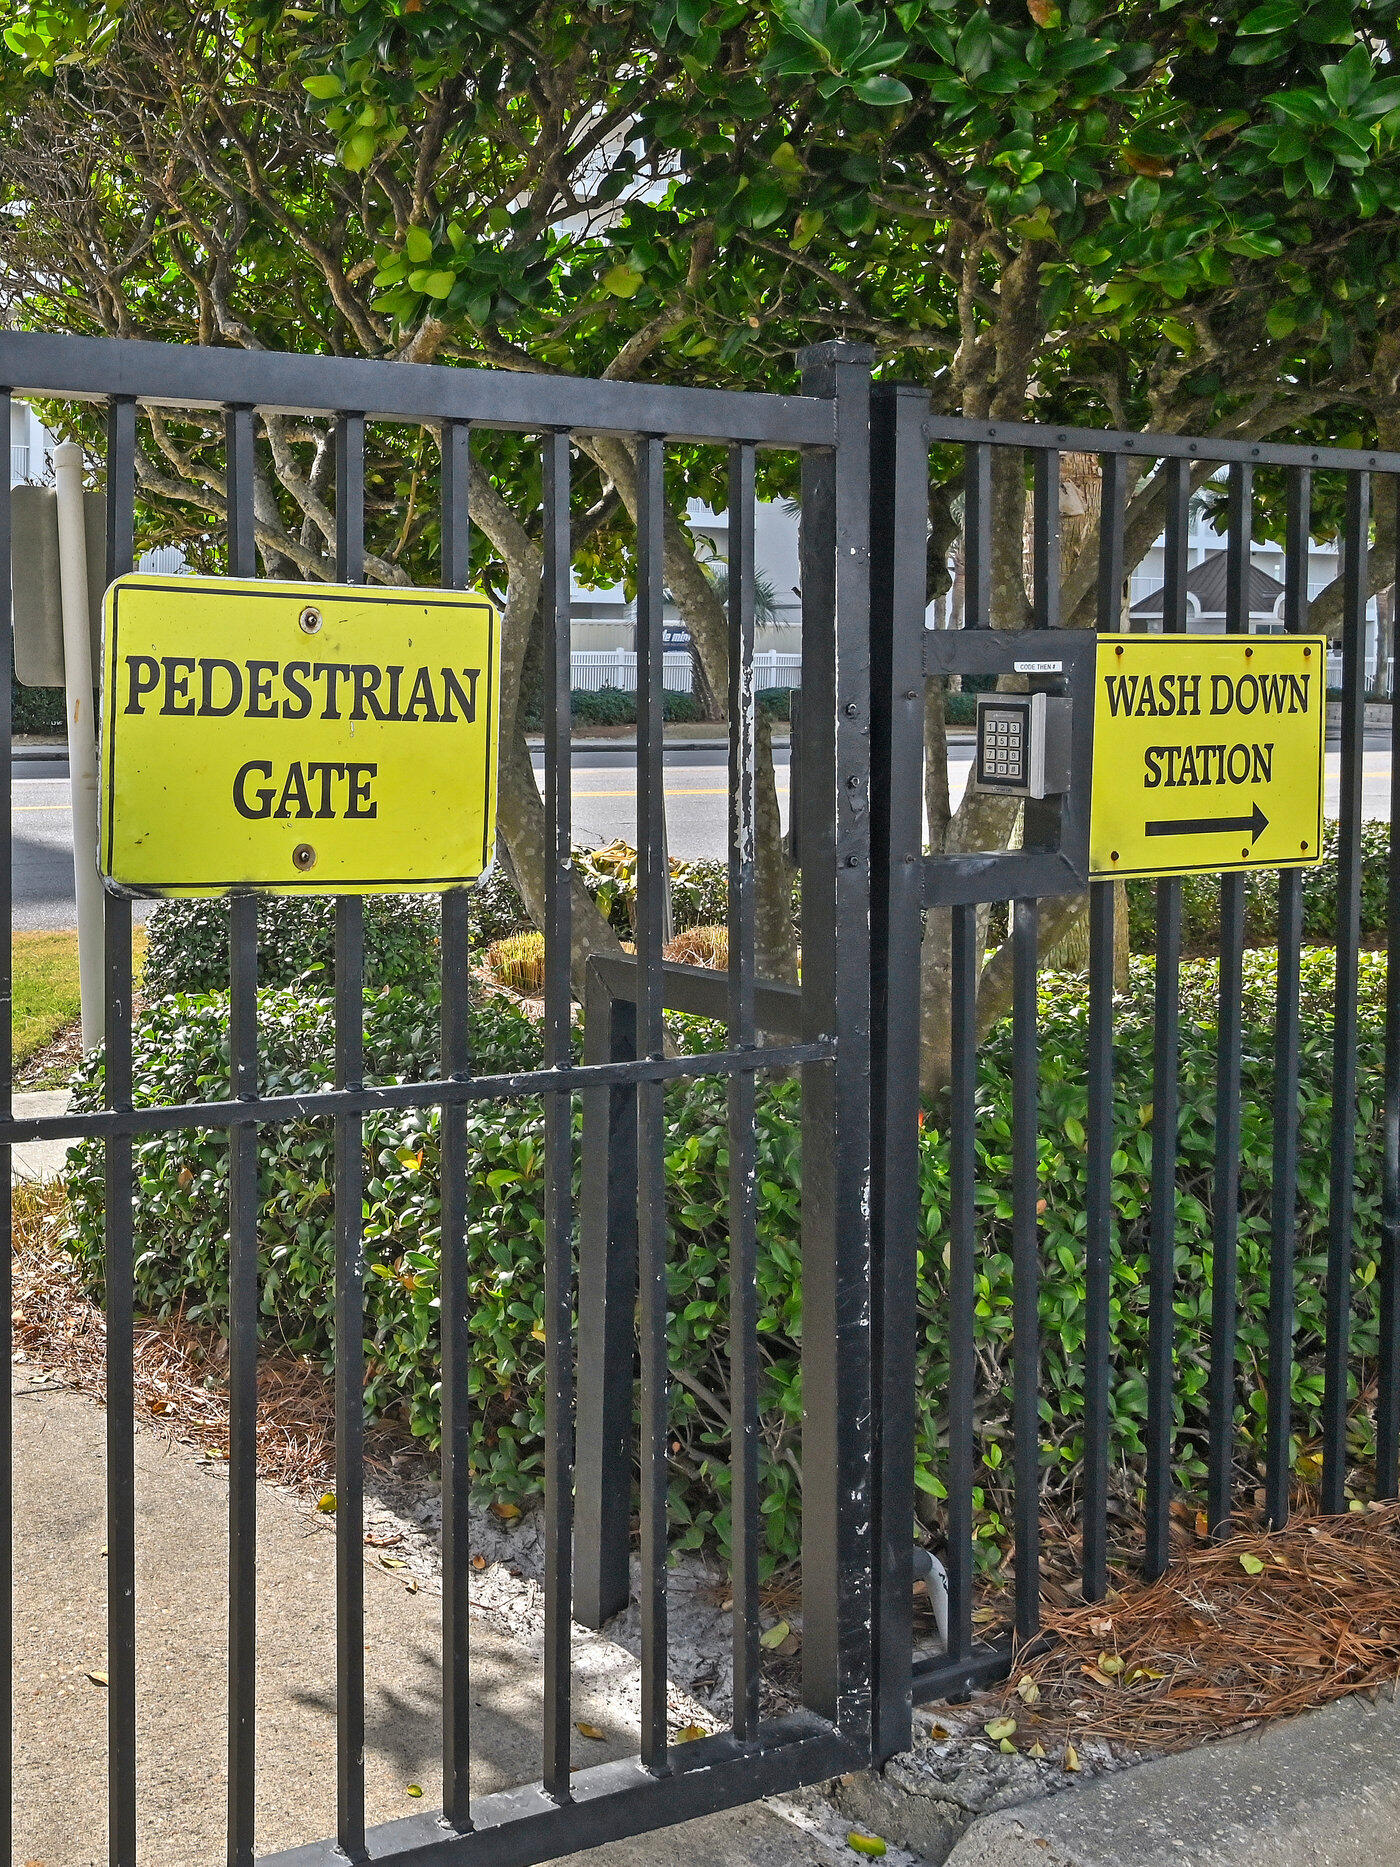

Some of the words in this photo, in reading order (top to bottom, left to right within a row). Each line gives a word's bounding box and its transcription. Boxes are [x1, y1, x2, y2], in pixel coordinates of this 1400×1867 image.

[124, 655, 481, 723] PEDESTRIAN
[1104, 674, 1201, 717] WASH
[1210, 673, 1311, 715] DOWN
[232, 759, 378, 820] GATE
[1144, 743, 1274, 788] STATION
